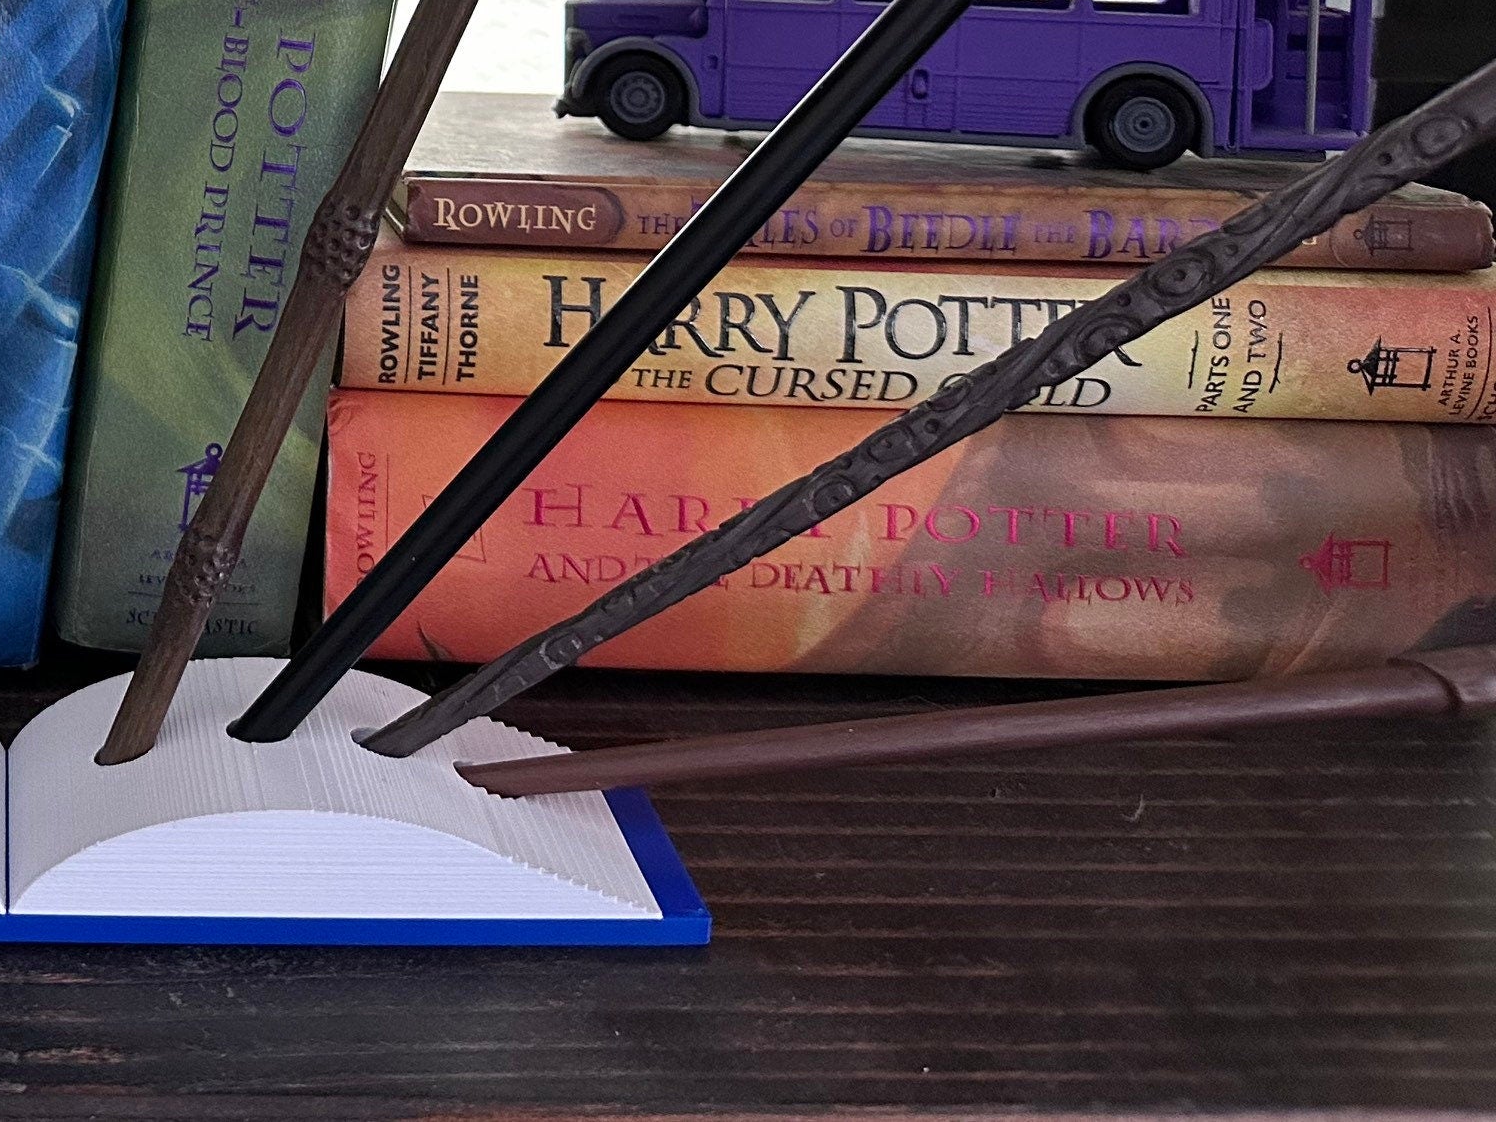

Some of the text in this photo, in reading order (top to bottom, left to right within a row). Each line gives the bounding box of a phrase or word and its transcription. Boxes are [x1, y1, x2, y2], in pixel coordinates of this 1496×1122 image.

[233, 28, 316, 342] POTTER
[432, 197, 598, 235] ROWLING
[829, 217, 858, 239] OF
[861, 204, 1022, 255] BEEDLE
[184, 180, 230, 344] PRINCE
[377, 264, 401, 384] ROWLING
[417, 273, 440, 382] TIFFANY
[456, 273, 479, 382] THORNE
[542, 274, 817, 362] HRRY
[1195, 296, 1231, 415] PARTS ONE
[1233, 298, 1267, 414] AND TWO
[1438, 329, 1462, 407] ARTHUR A.
[1448, 315, 1479, 416] LEVINE BOOKS
[631, 367, 693, 389] THE
[704, 363, 919, 402] CURSED
[526, 552, 627, 584] AND
[750, 560, 960, 597] DEATHLY
[978, 570, 1196, 606] HALLOWS
[878, 503, 1186, 558] POTTER
